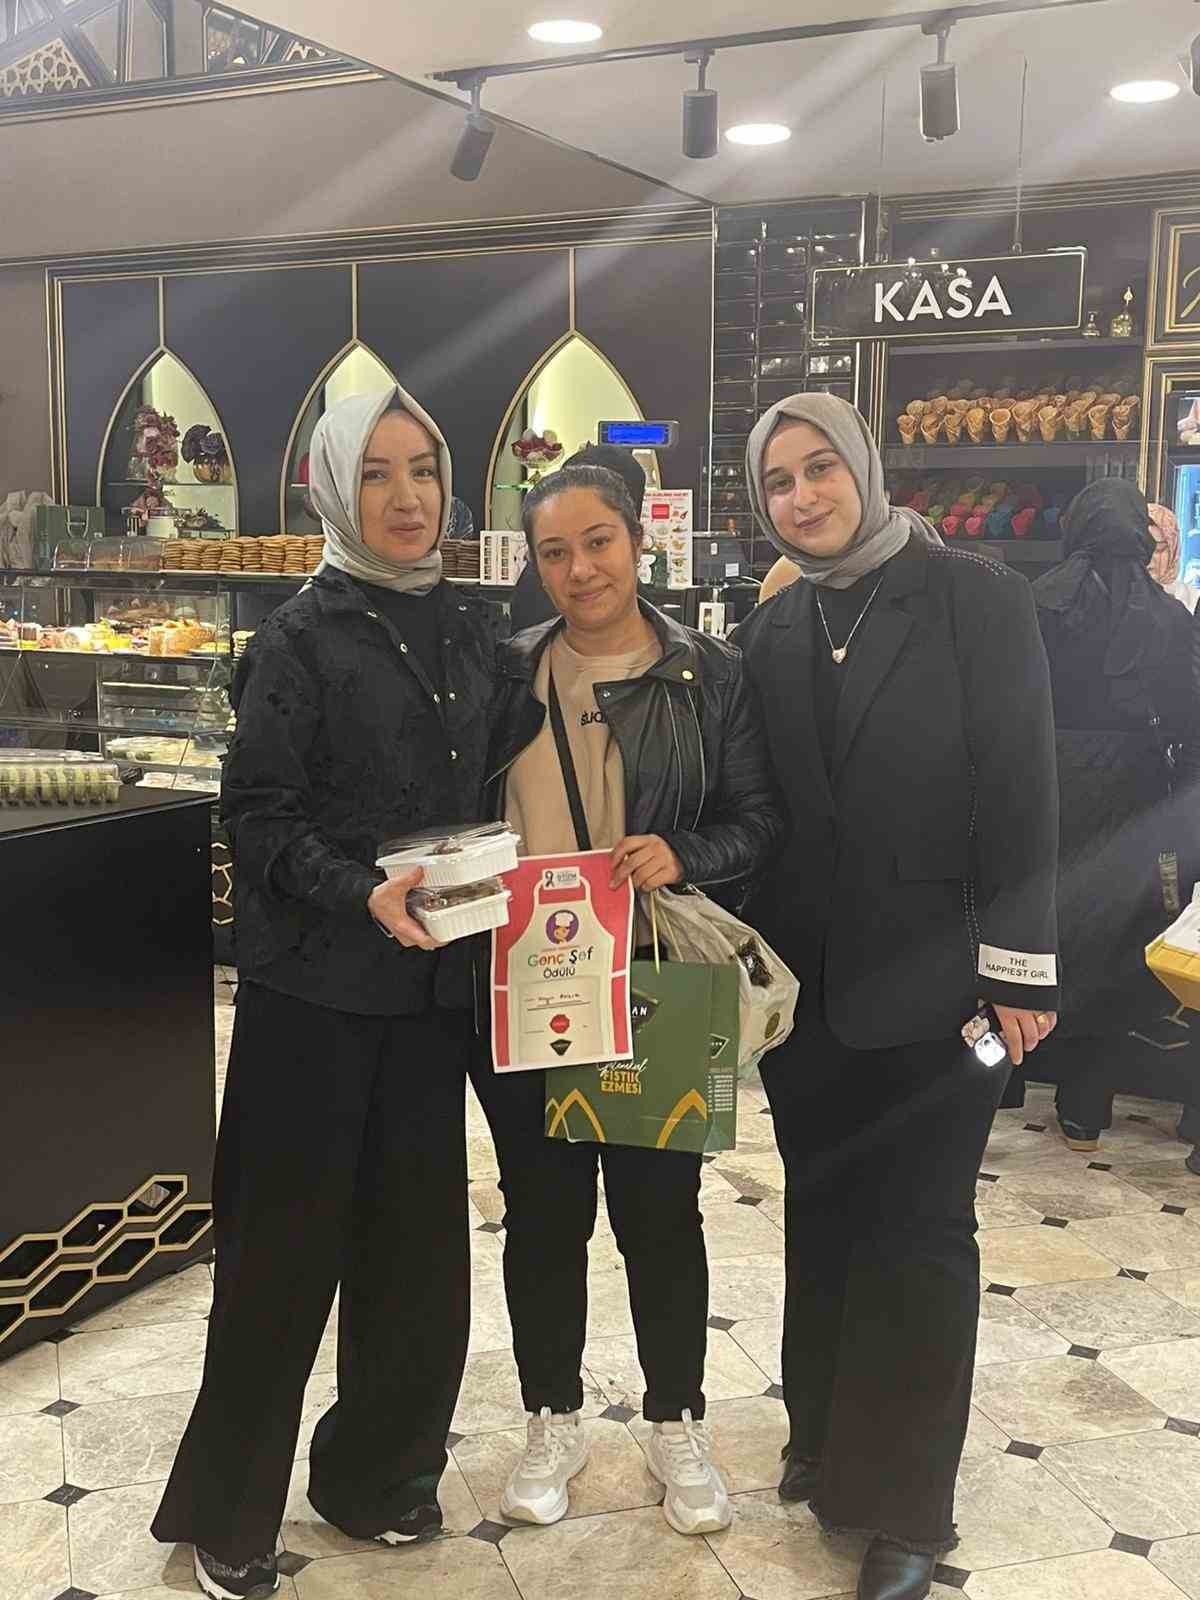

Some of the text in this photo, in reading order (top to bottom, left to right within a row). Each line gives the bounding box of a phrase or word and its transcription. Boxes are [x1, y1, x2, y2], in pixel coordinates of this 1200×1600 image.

[874, 275, 1012, 323] KASA
[985, 961, 1049, 979] HAPPIEST GIRL
[1009, 957, 1028, 968] THE
